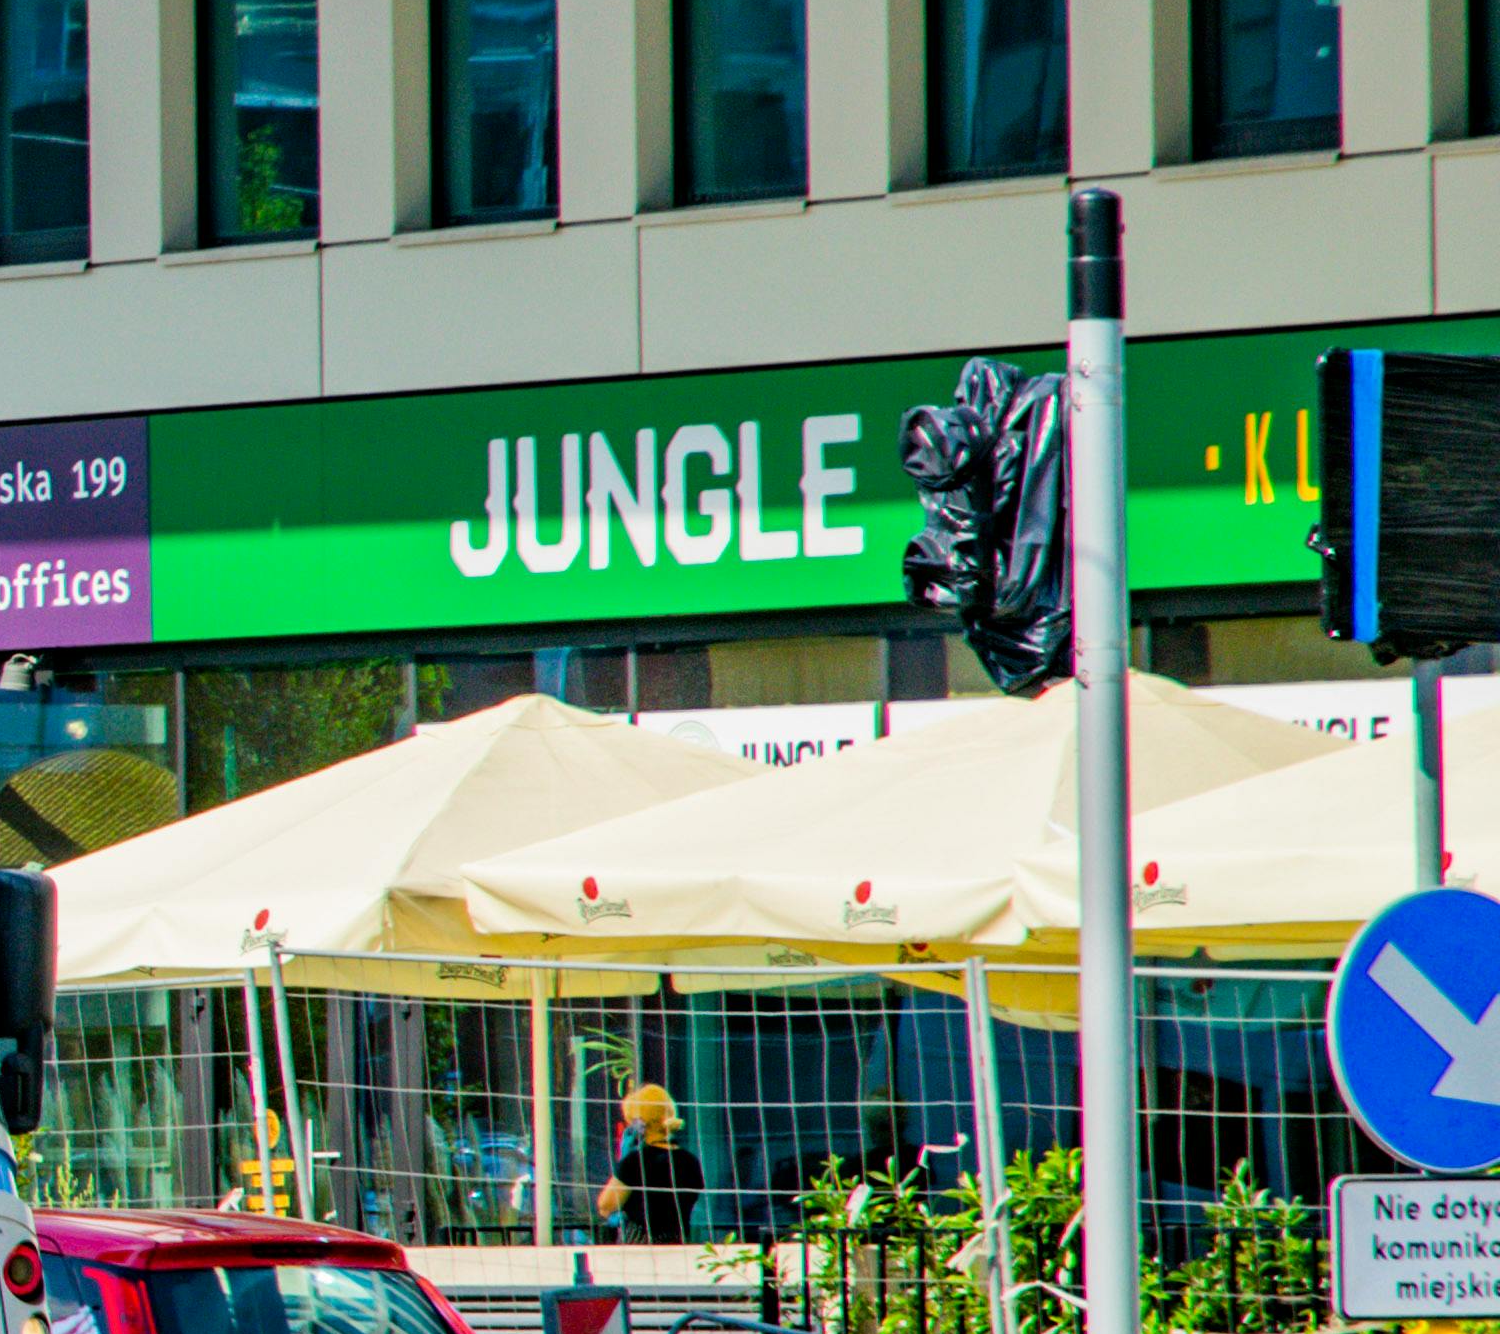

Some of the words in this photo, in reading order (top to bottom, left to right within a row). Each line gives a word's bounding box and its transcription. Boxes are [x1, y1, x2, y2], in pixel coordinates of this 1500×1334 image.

[71, 456, 127, 499] 199
[449, 413, 865, 578] JUNGLE
[1374, 1193, 1420, 1220] Nie
